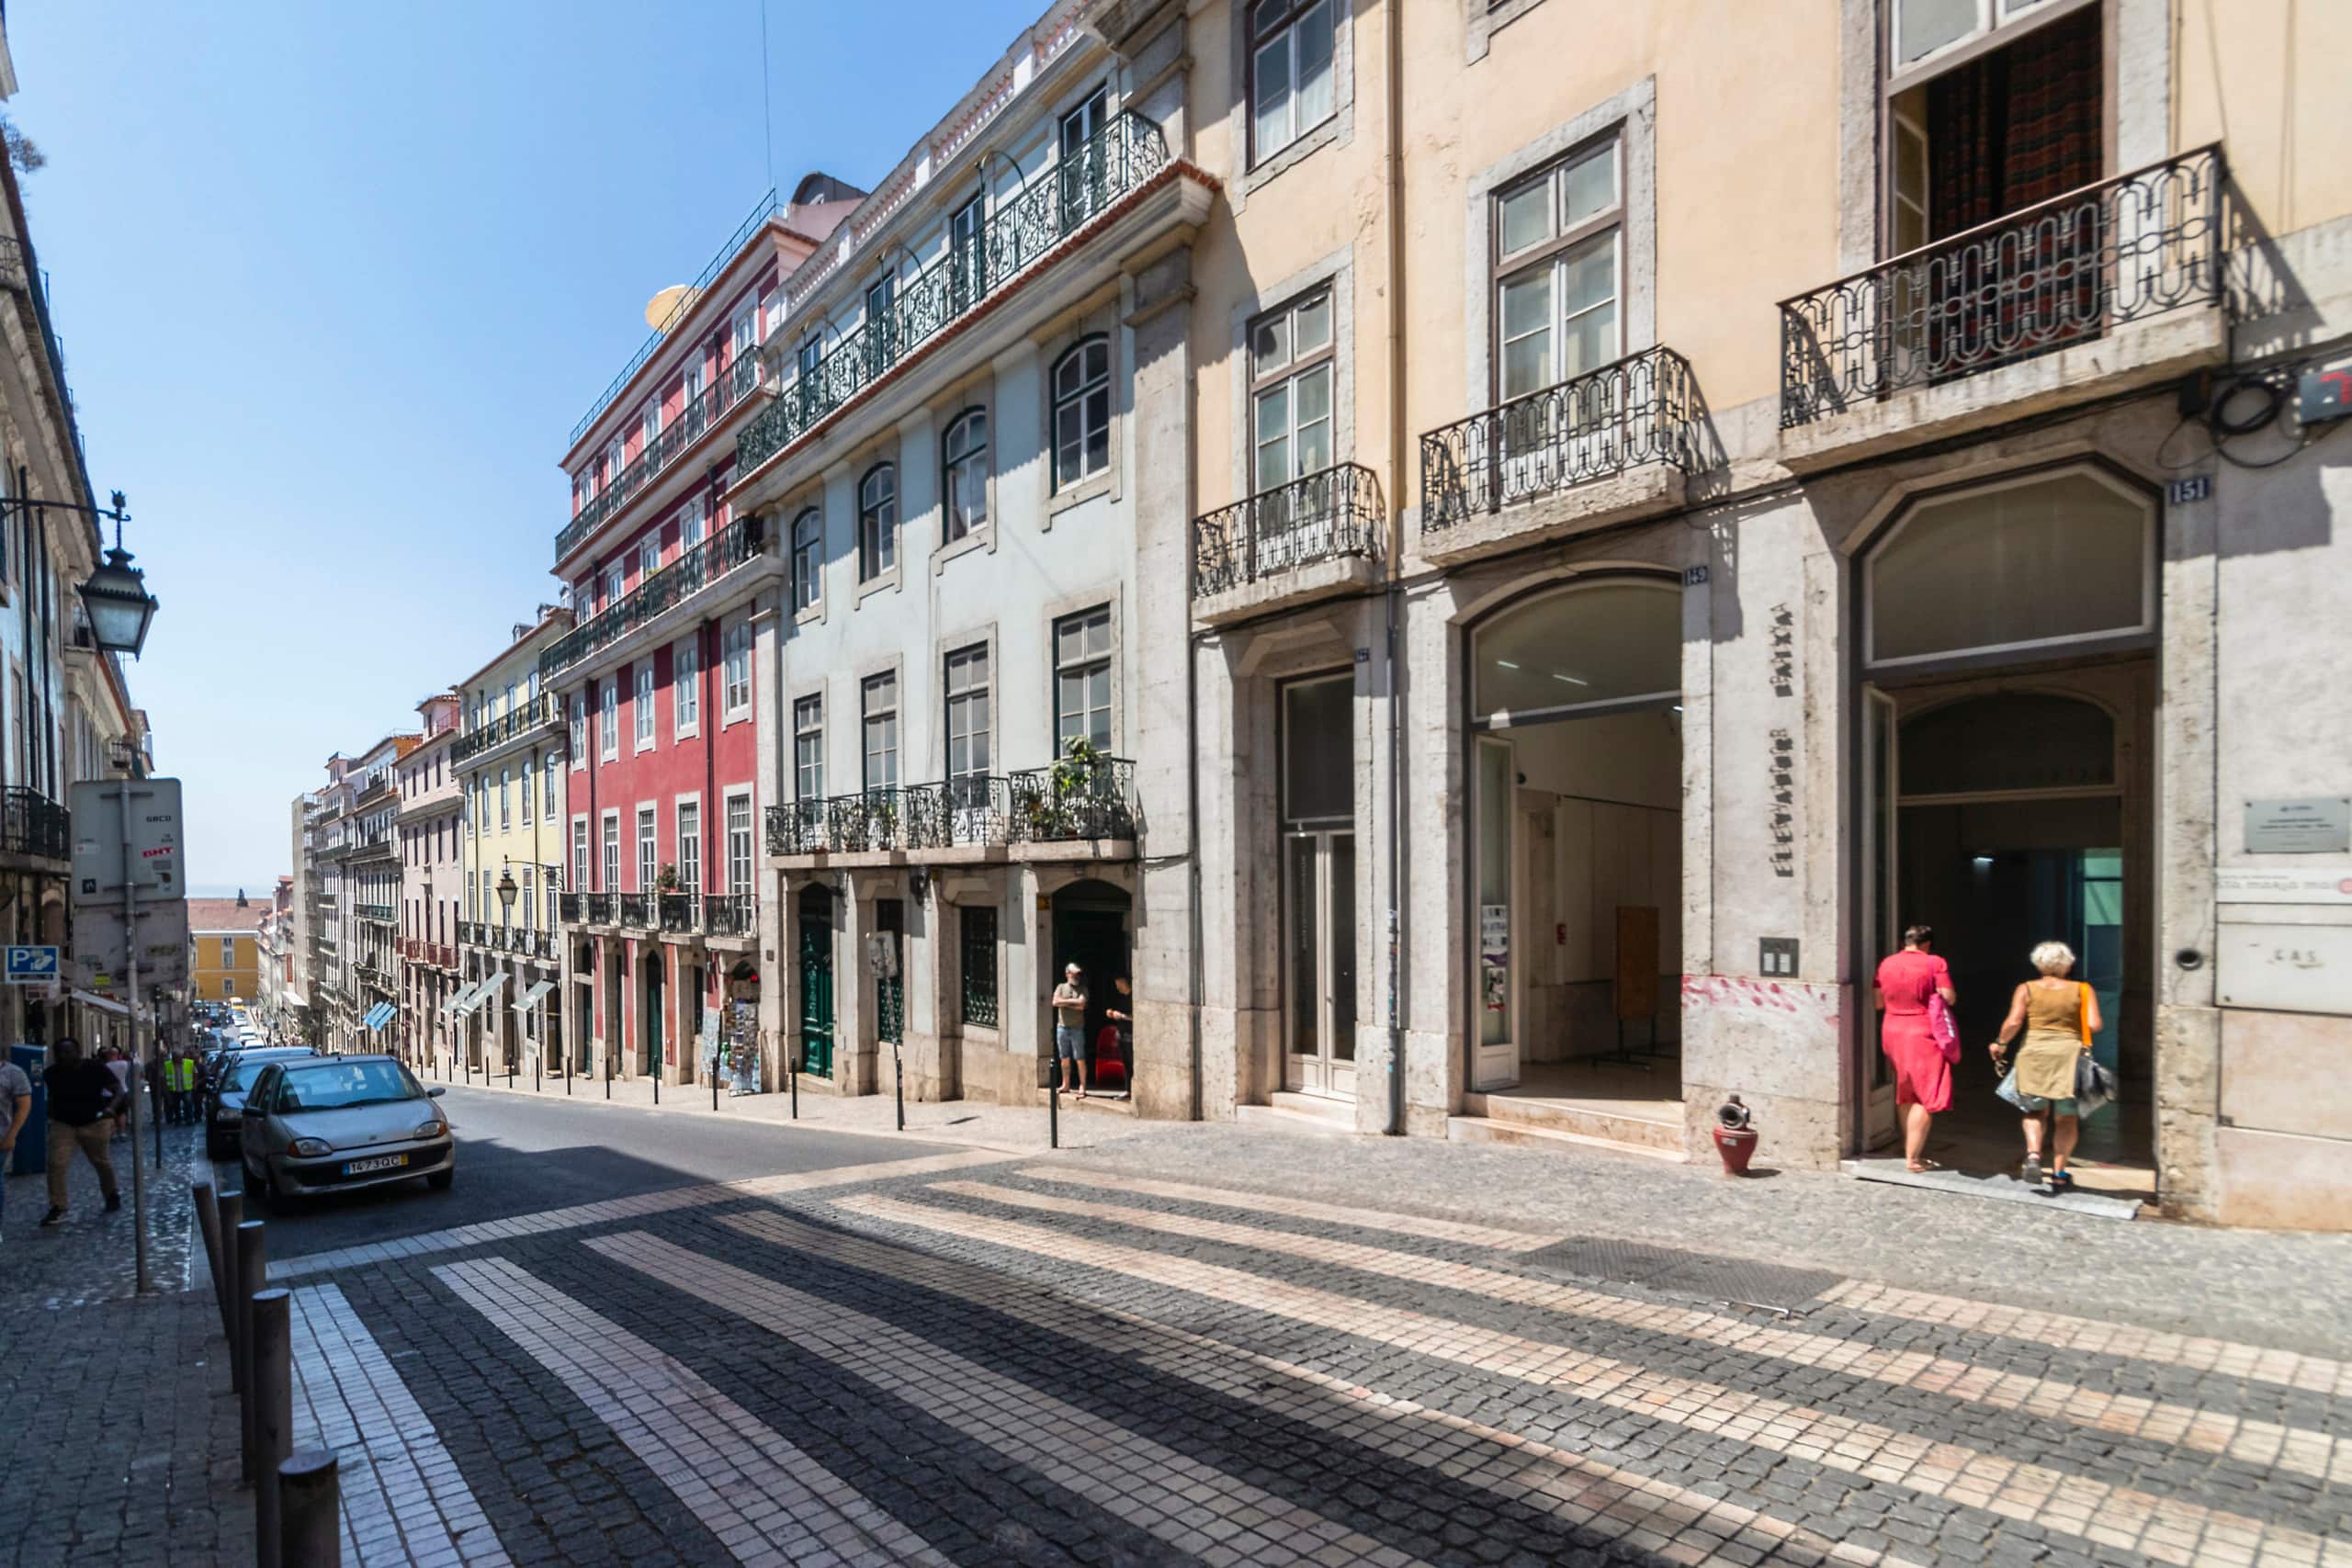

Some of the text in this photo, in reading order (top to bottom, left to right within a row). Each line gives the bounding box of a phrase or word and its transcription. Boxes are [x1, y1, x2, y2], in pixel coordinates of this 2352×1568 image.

[2174, 477, 2207, 502] 151
[1770, 603, 1793, 697] BAIXA
[12, 949, 30, 968] P
